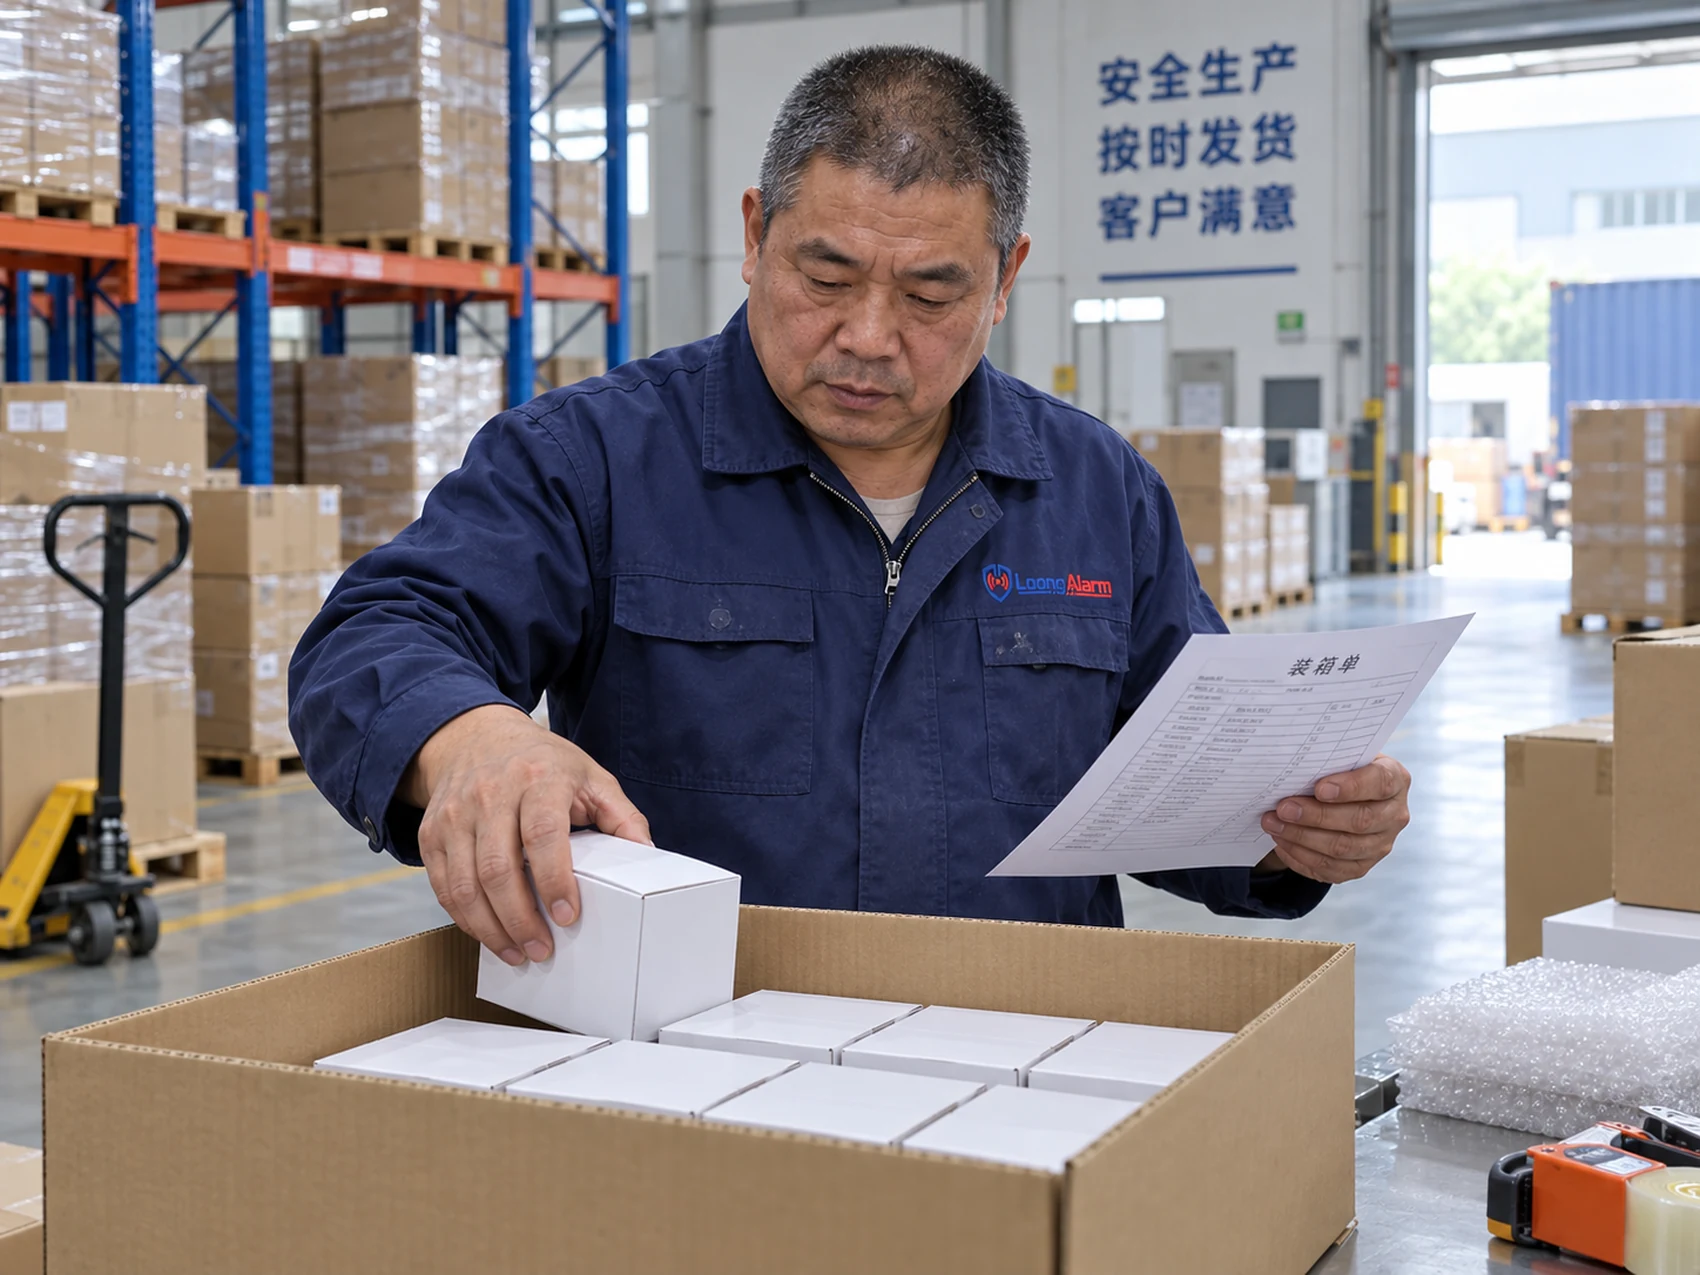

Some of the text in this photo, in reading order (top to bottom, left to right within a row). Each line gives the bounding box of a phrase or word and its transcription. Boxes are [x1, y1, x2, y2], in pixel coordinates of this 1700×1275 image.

[1098, 41, 1297, 106] 安全生产
[1098, 112, 1297, 174] 按时发货
[1098, 183, 1297, 242] 客户满意
[1287, 653, 1361, 677] 装箱单
